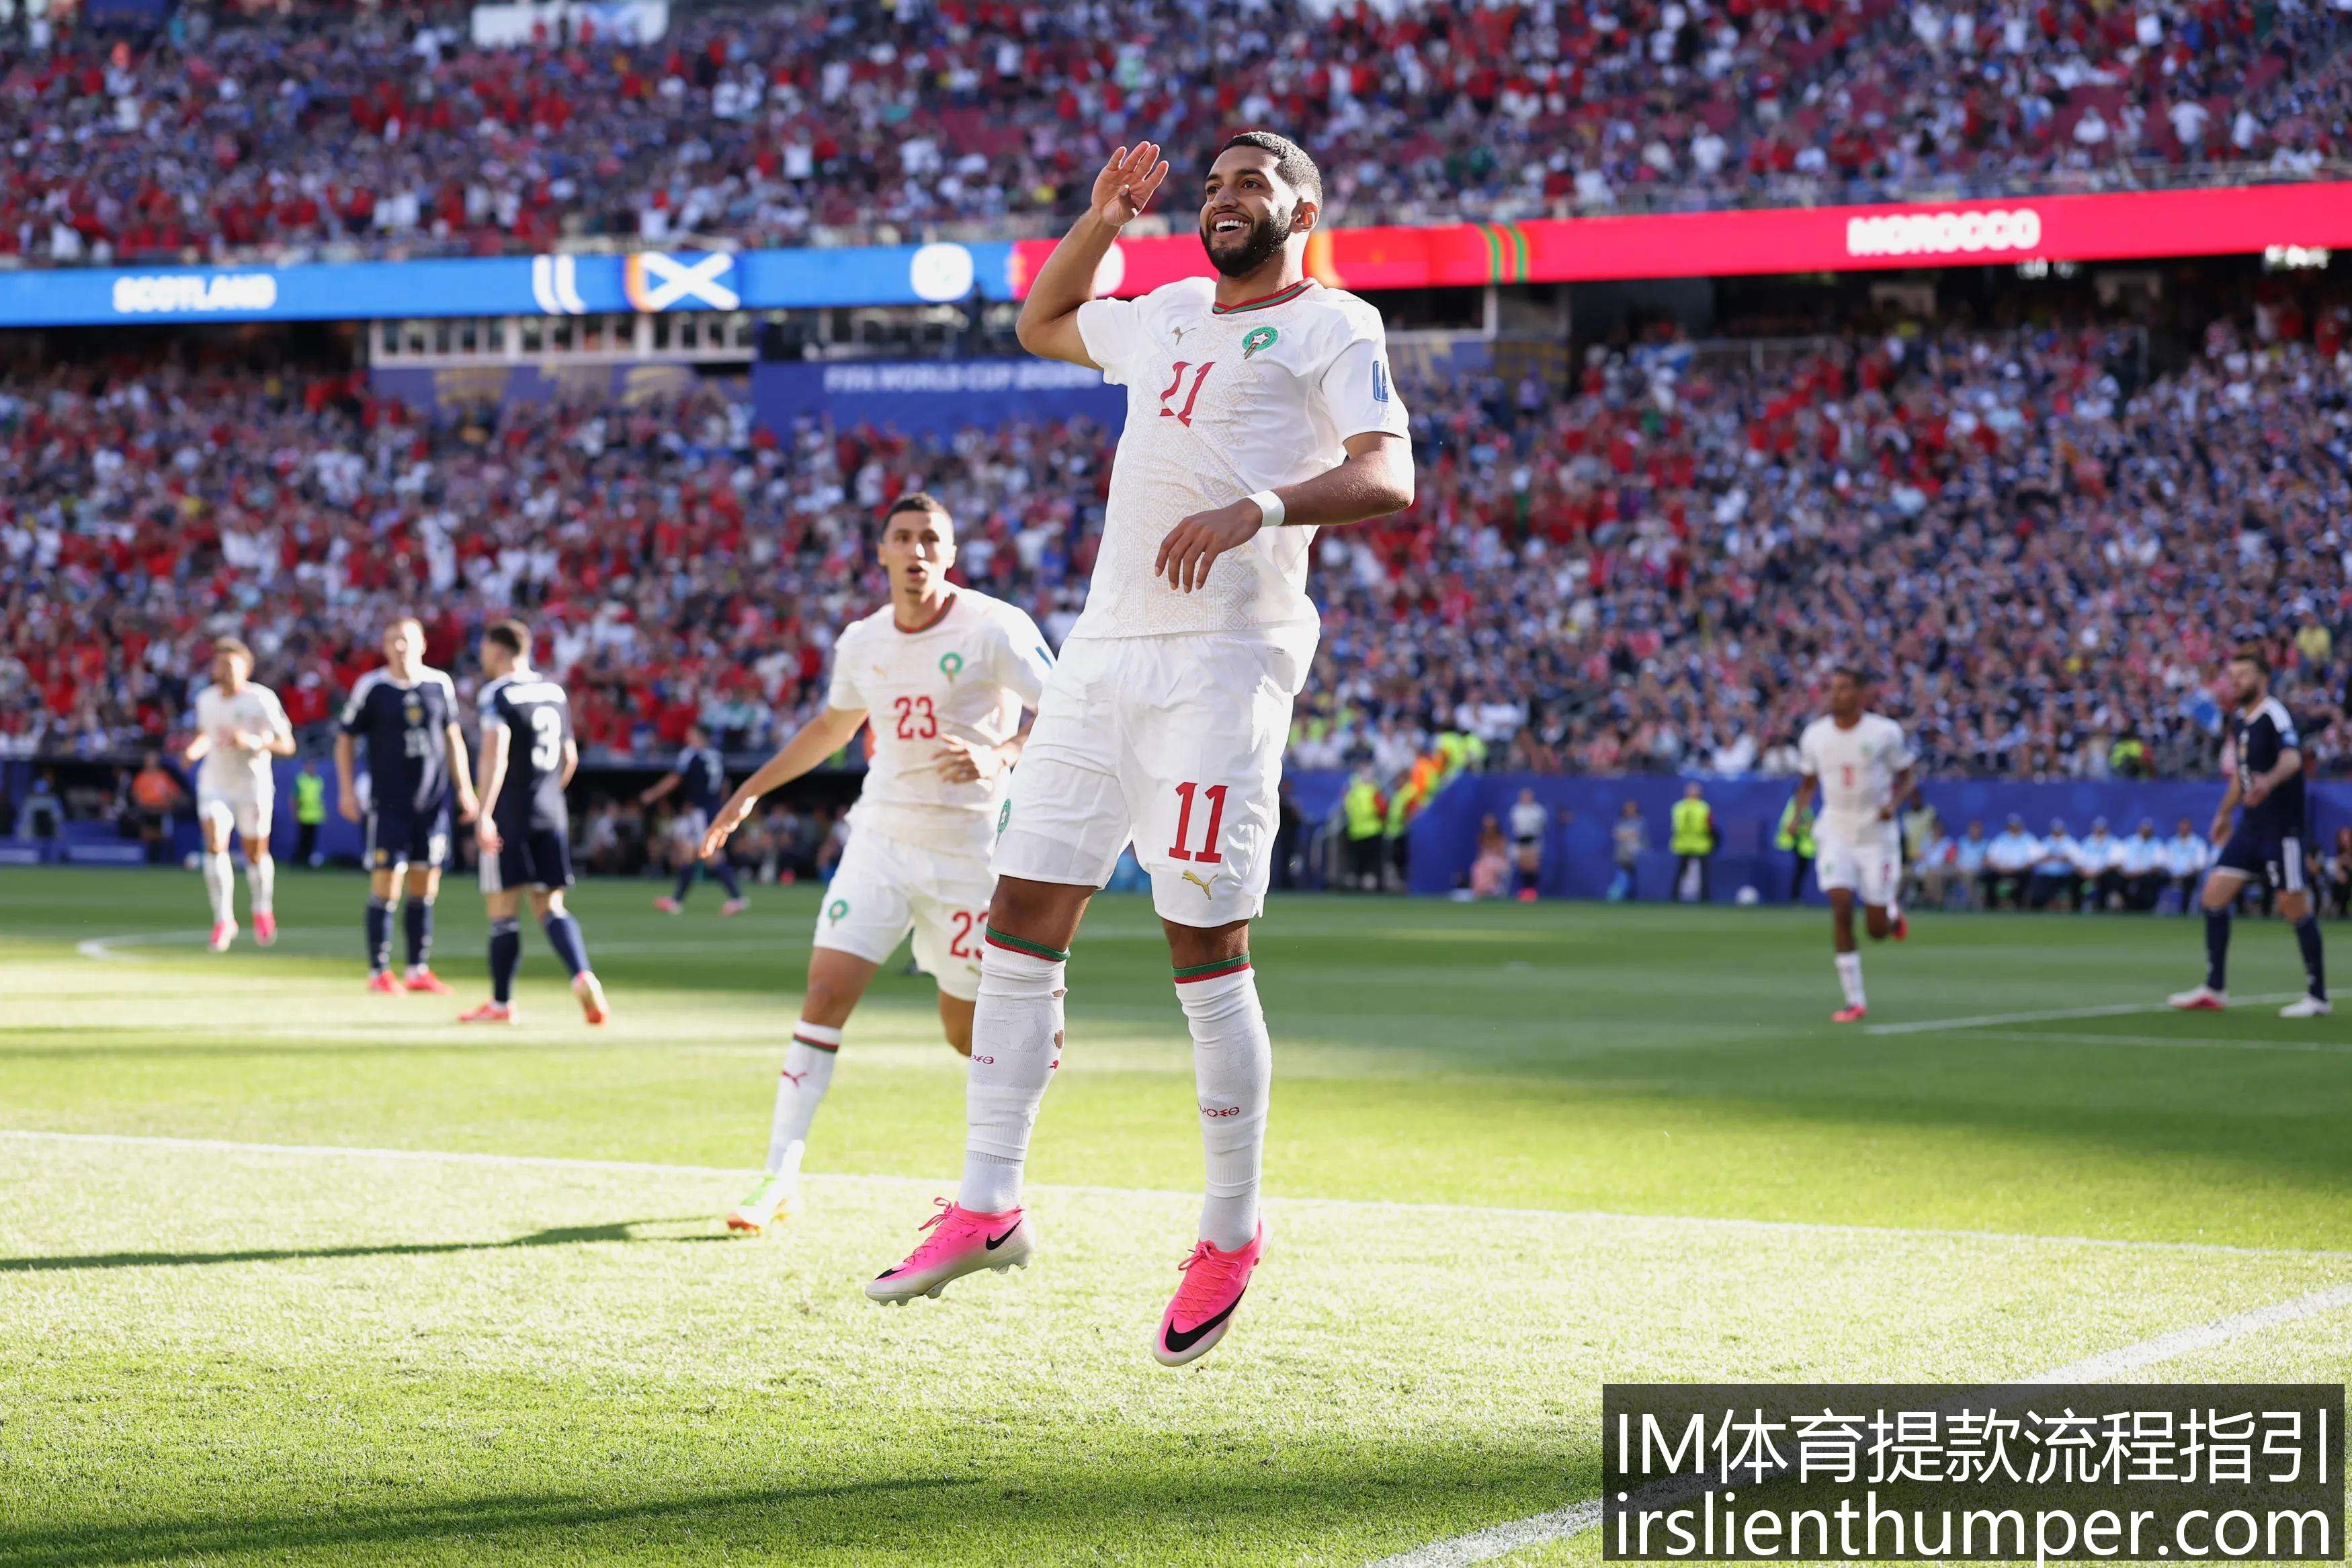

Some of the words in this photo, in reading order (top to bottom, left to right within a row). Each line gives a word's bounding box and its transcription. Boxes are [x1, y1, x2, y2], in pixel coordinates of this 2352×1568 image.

[1847, 208, 2042, 257] MOROCCO
[113, 273, 277, 313] SCOTLAND
[531, 705, 562, 771] 3
[894, 695, 937, 740] 23
[1169, 781, 1230, 863] 11
